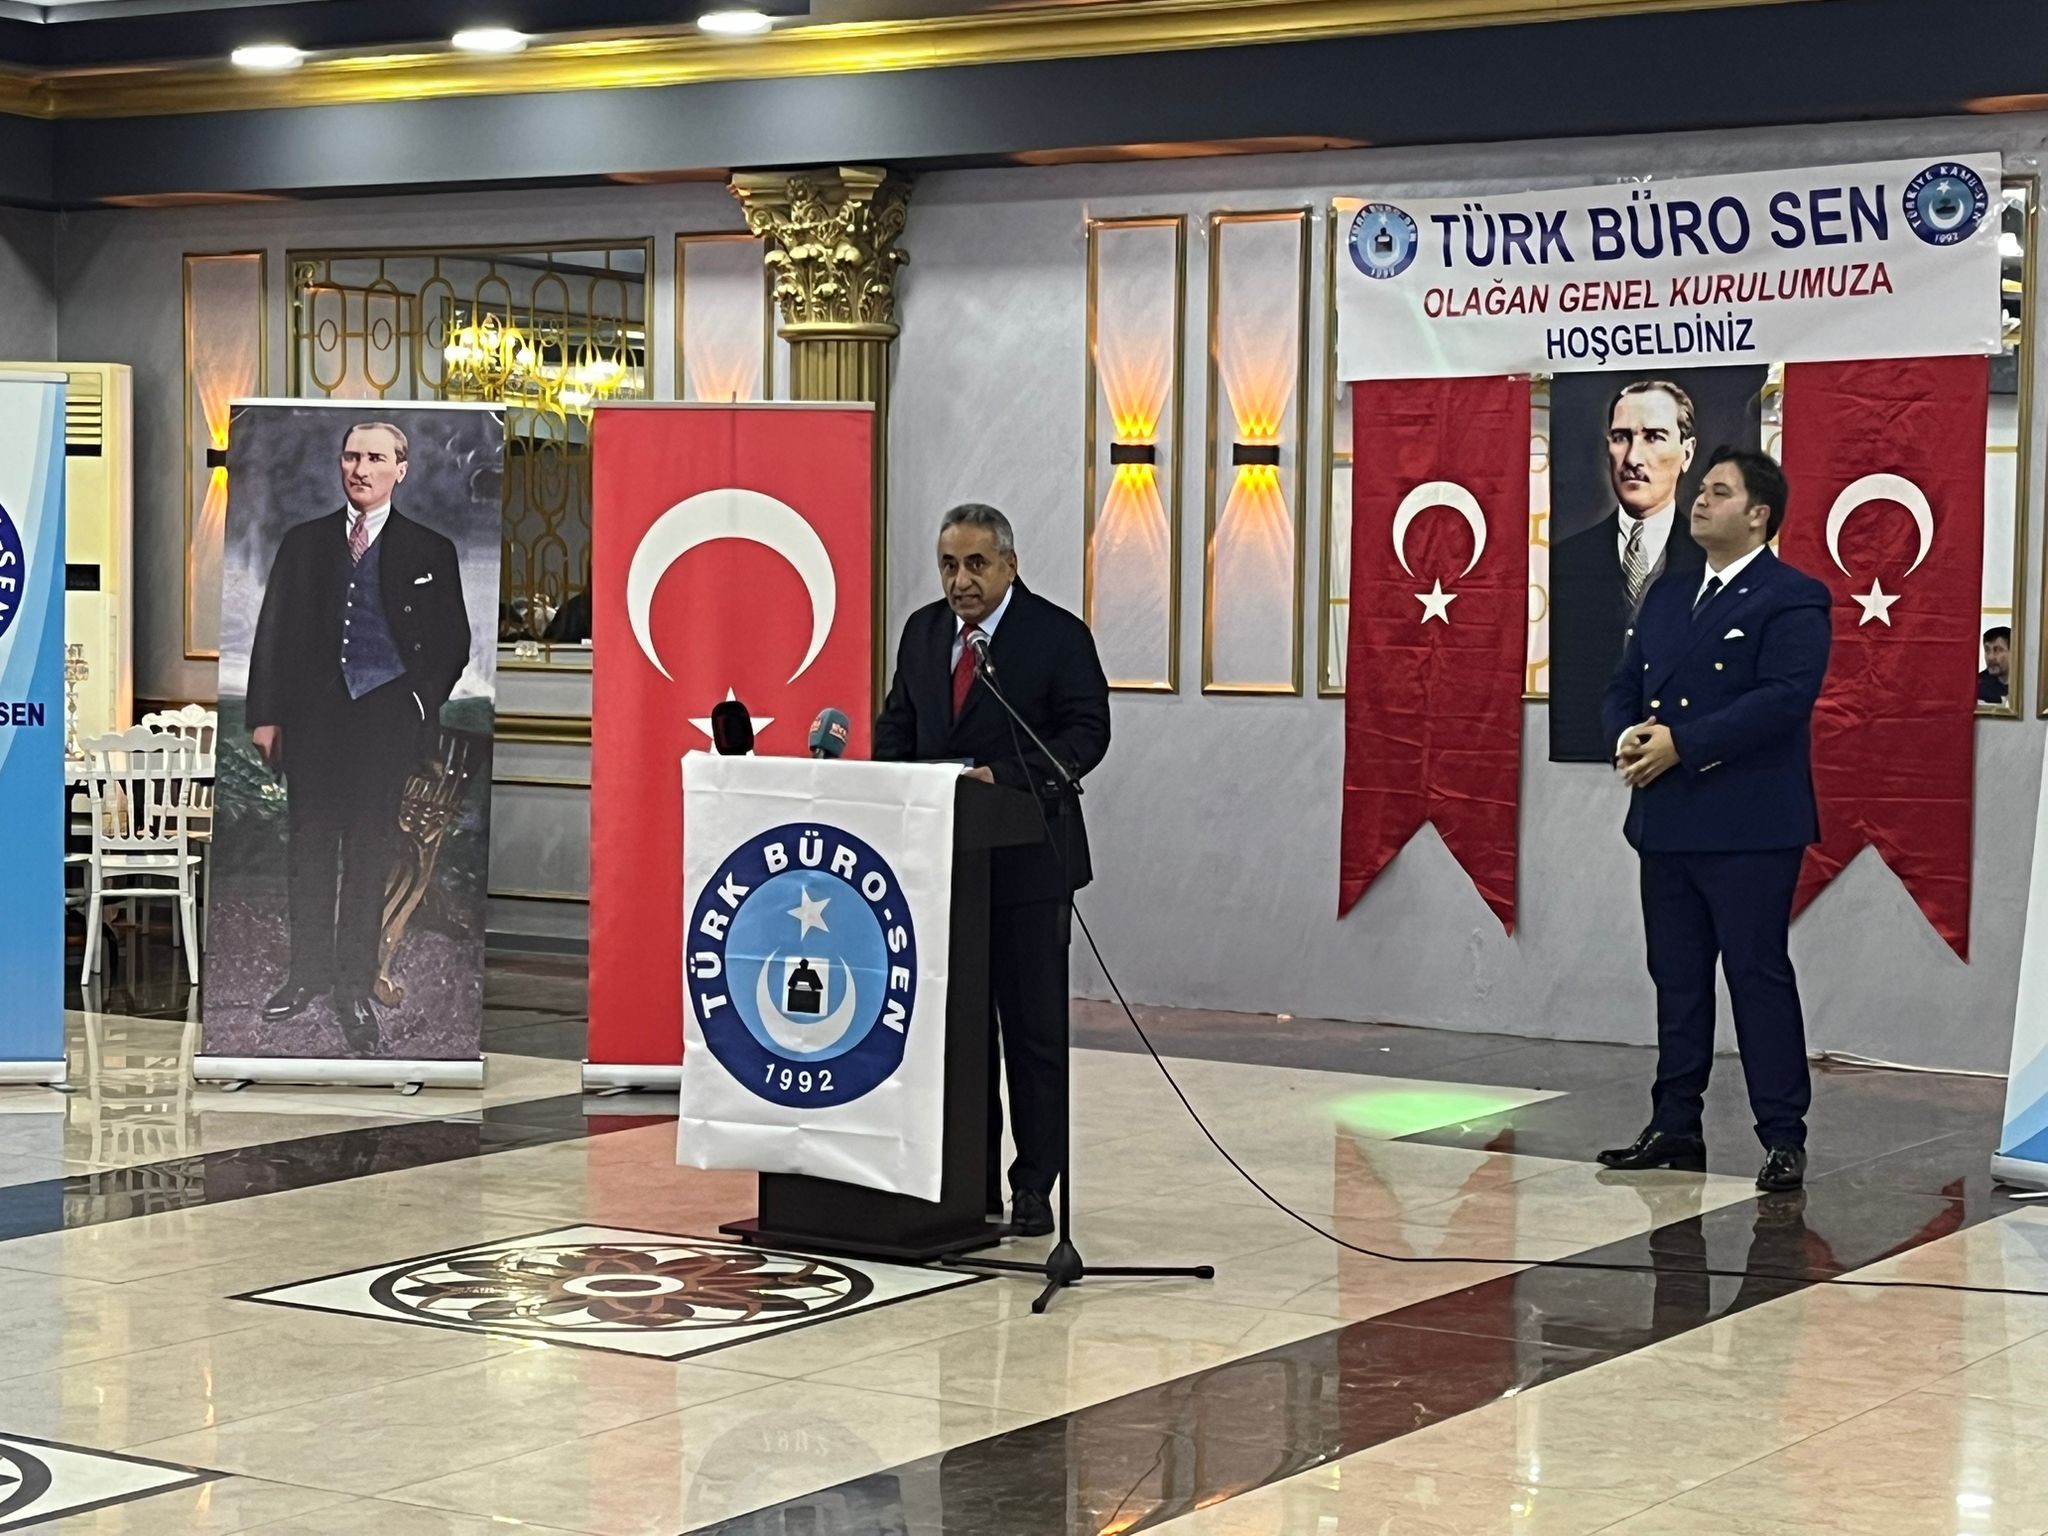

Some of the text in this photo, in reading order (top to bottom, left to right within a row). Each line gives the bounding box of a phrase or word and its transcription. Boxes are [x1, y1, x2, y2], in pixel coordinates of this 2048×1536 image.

[1430, 184, 1889, 267] TÜRK BÜRO SEN
[1424, 262, 1894, 319] OLAĞAN GENEL KURULUMUZA
[1547, 312, 1755, 365] HOŞGELDİNİZ
[691, 830, 910, 1034] TÜRK BÜRO-SEN
[764, 1063, 834, 1093] 1992
